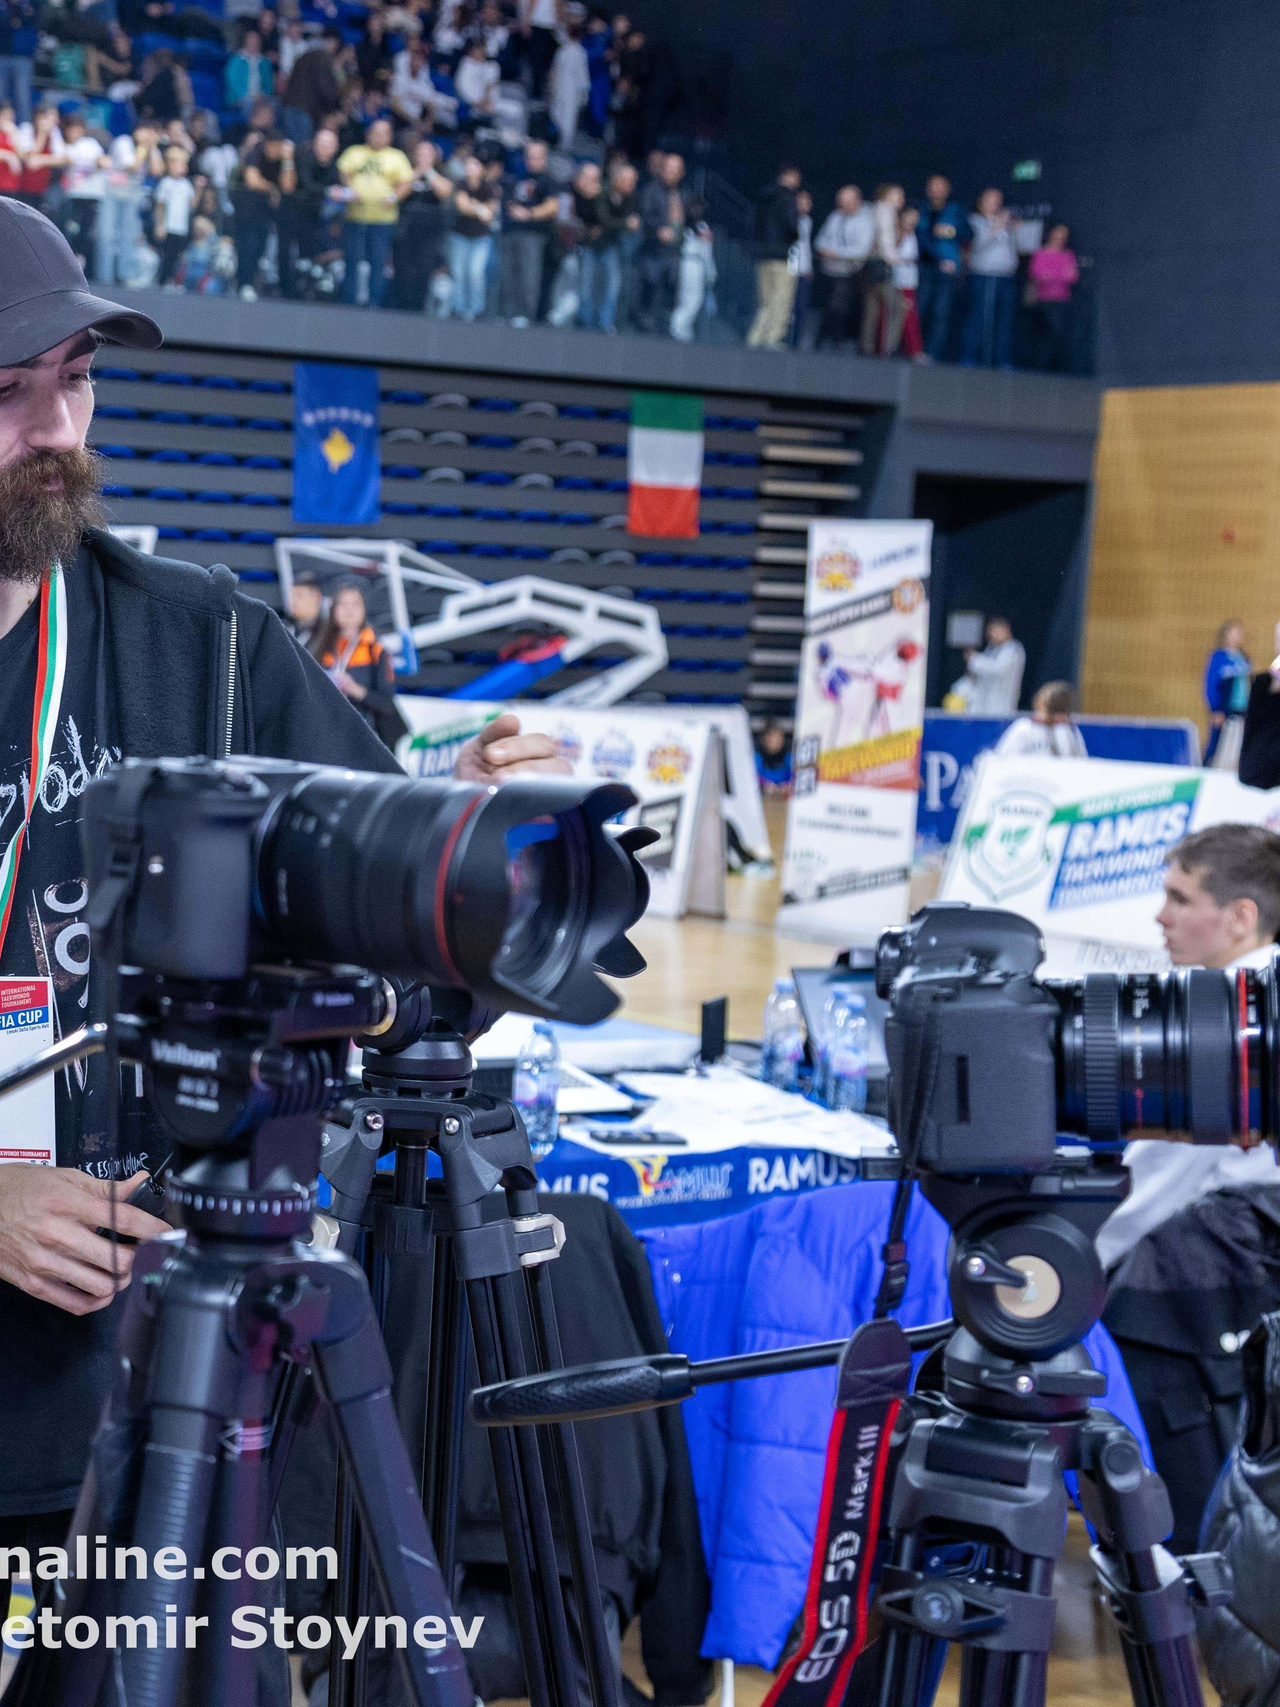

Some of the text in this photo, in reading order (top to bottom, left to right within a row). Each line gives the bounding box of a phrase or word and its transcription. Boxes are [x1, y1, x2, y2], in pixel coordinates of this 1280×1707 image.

[1065, 803, 1190, 860] RAMUS
[1, 985, 36, 996] INTERNATIONAL
[1, 992, 30, 1002] TAEKWONDO
[1, 998, 32, 1008] TOURNAMENT
[18, 1009, 43, 1025] CUP
[746, 1150, 857, 1194] RAMUS
[794, 1424, 880, 1684] EOS 5D Mark III
